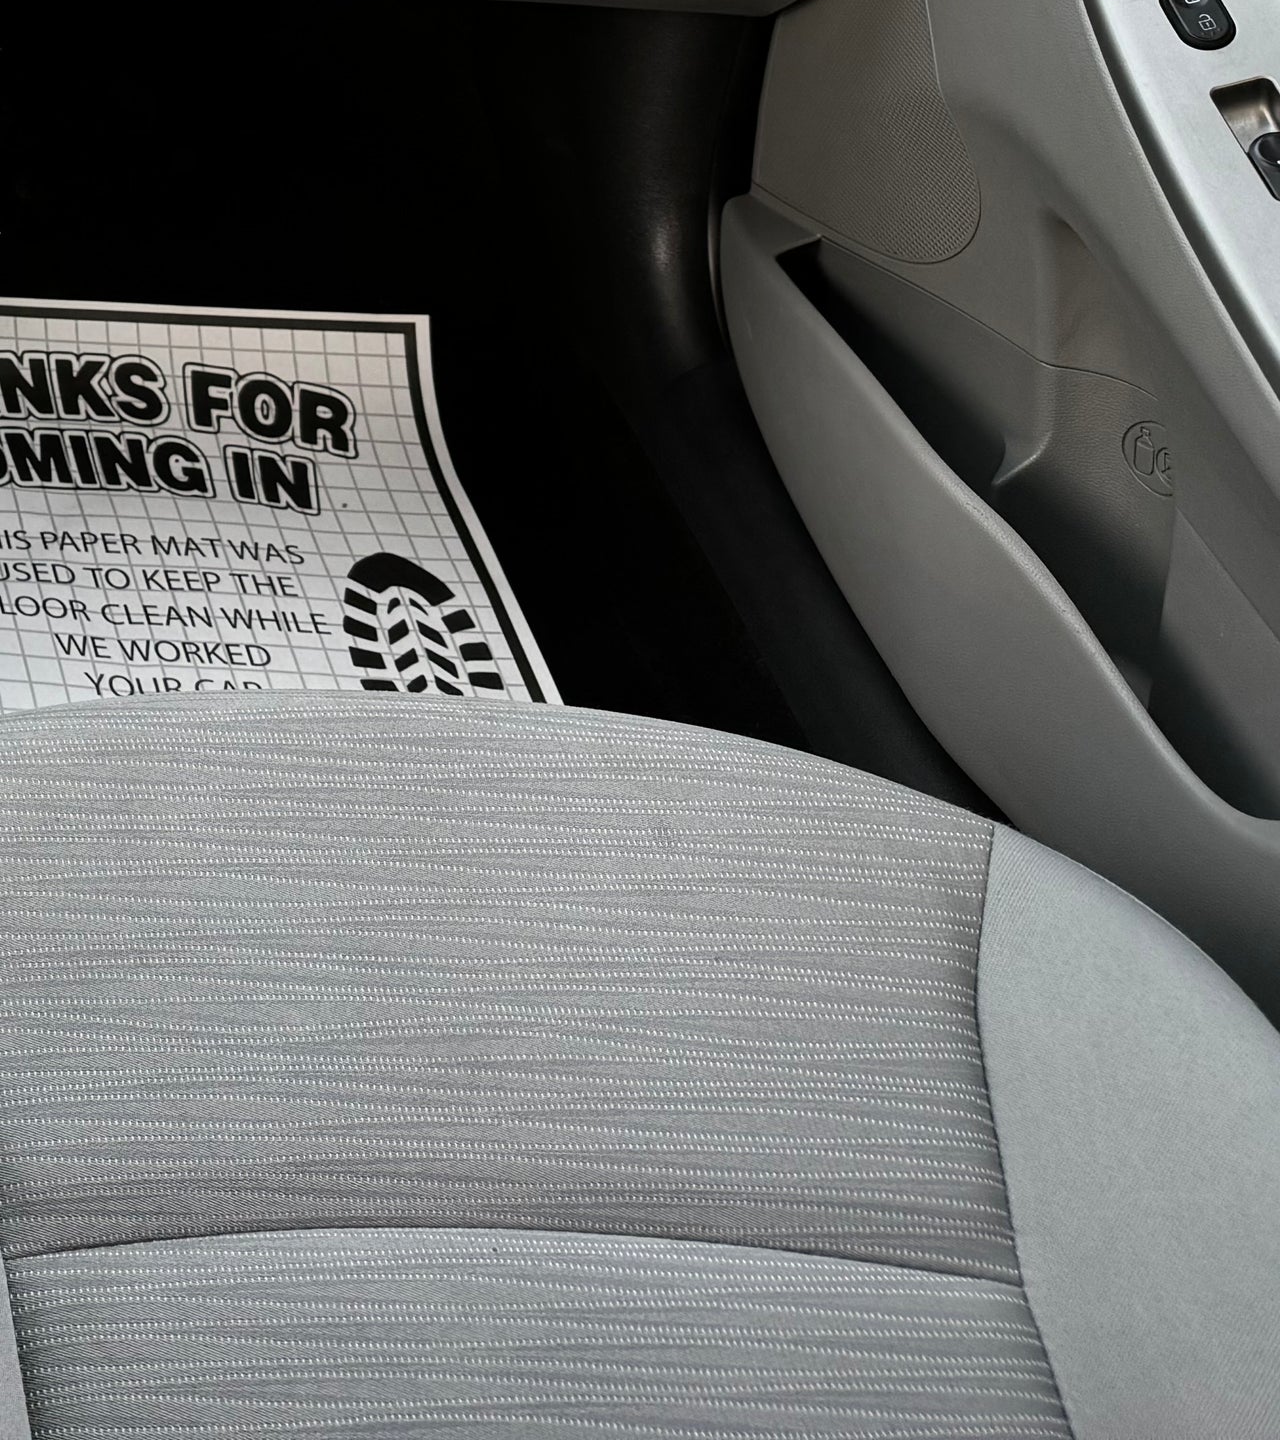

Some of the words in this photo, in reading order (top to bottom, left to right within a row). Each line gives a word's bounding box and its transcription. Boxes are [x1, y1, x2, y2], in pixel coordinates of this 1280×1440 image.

[182, 362, 359, 459] FOR
[223, 444, 321, 516] IN
[39, 531, 142, 555] PAPER
[151, 535, 221, 559] MAT
[227, 539, 305, 565] WAS
[83, 567, 131, 590] TO
[142, 569, 222, 593] KEEP
[228, 573, 299, 597] THE
[101, 603, 213, 628] CLEAN
[220, 607, 332, 635] WHILE
[54, 633, 112, 659] WE
[117, 639, 272, 667] WORKED
[84, 672, 181, 697] YOUR
